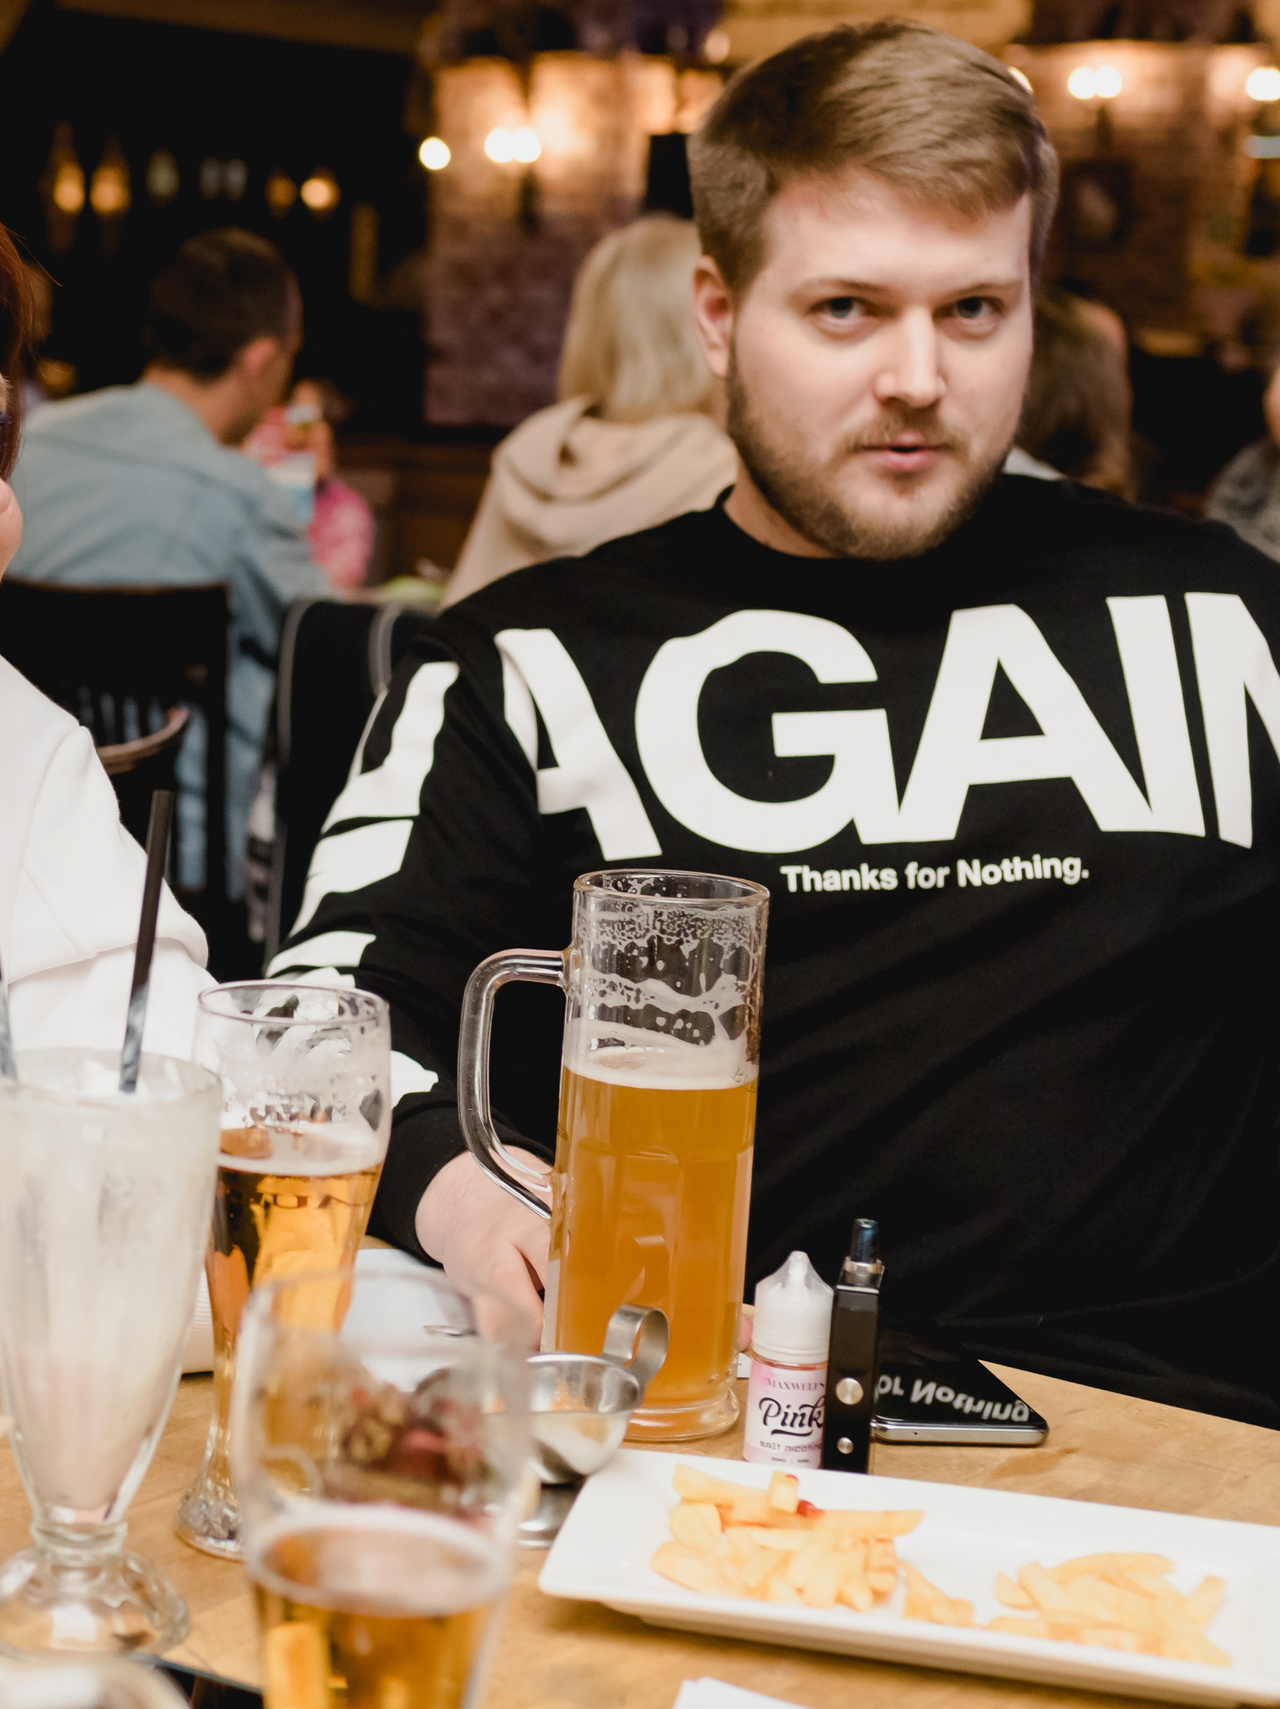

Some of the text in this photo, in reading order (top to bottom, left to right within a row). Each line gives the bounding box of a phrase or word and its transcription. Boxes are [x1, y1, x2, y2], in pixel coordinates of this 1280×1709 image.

[779, 853, 1090, 893] Thanks for Nothing.
[758, 1395, 826, 1429] Pink
[784, 1443, 823, 1453] nicotin
